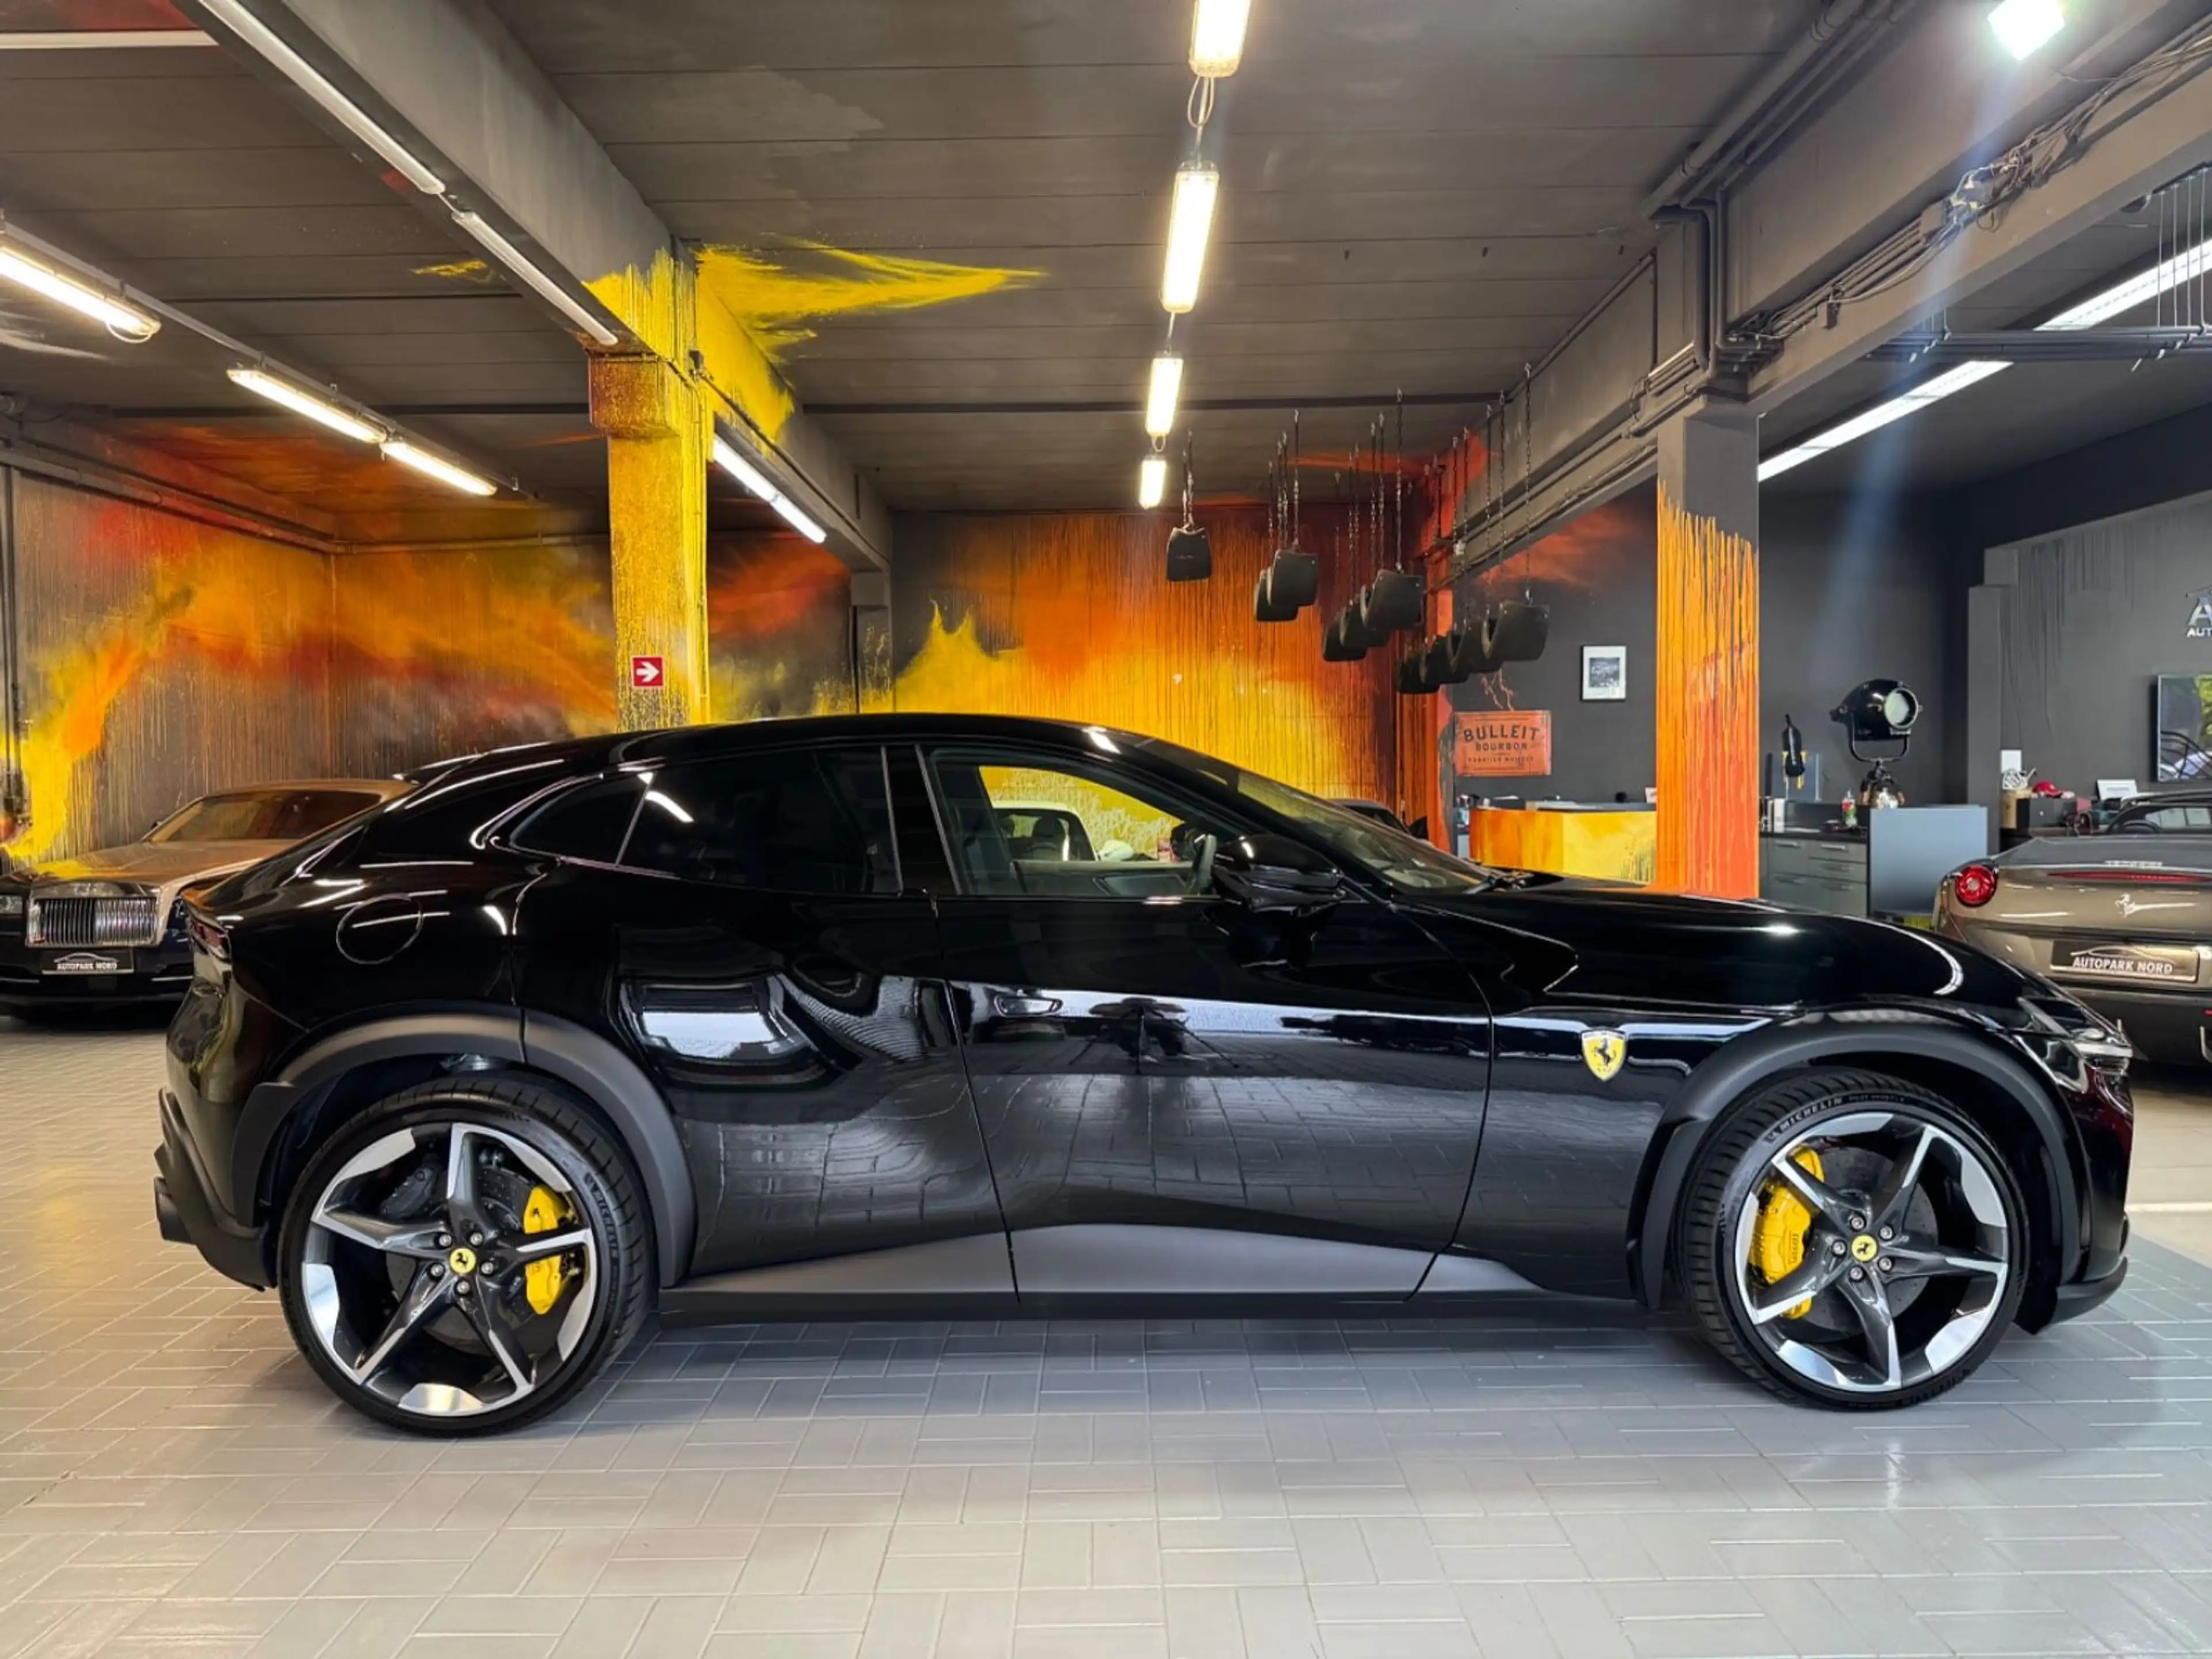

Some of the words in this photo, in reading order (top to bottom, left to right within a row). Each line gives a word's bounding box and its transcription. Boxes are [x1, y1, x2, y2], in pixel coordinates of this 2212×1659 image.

[1464, 724, 1540, 742] BULLEIT
[2073, 957, 2134, 971] AUTOPARK
[2137, 961, 2173, 975] NORD
[1779, 1097, 1844, 1131] MICHELIN
